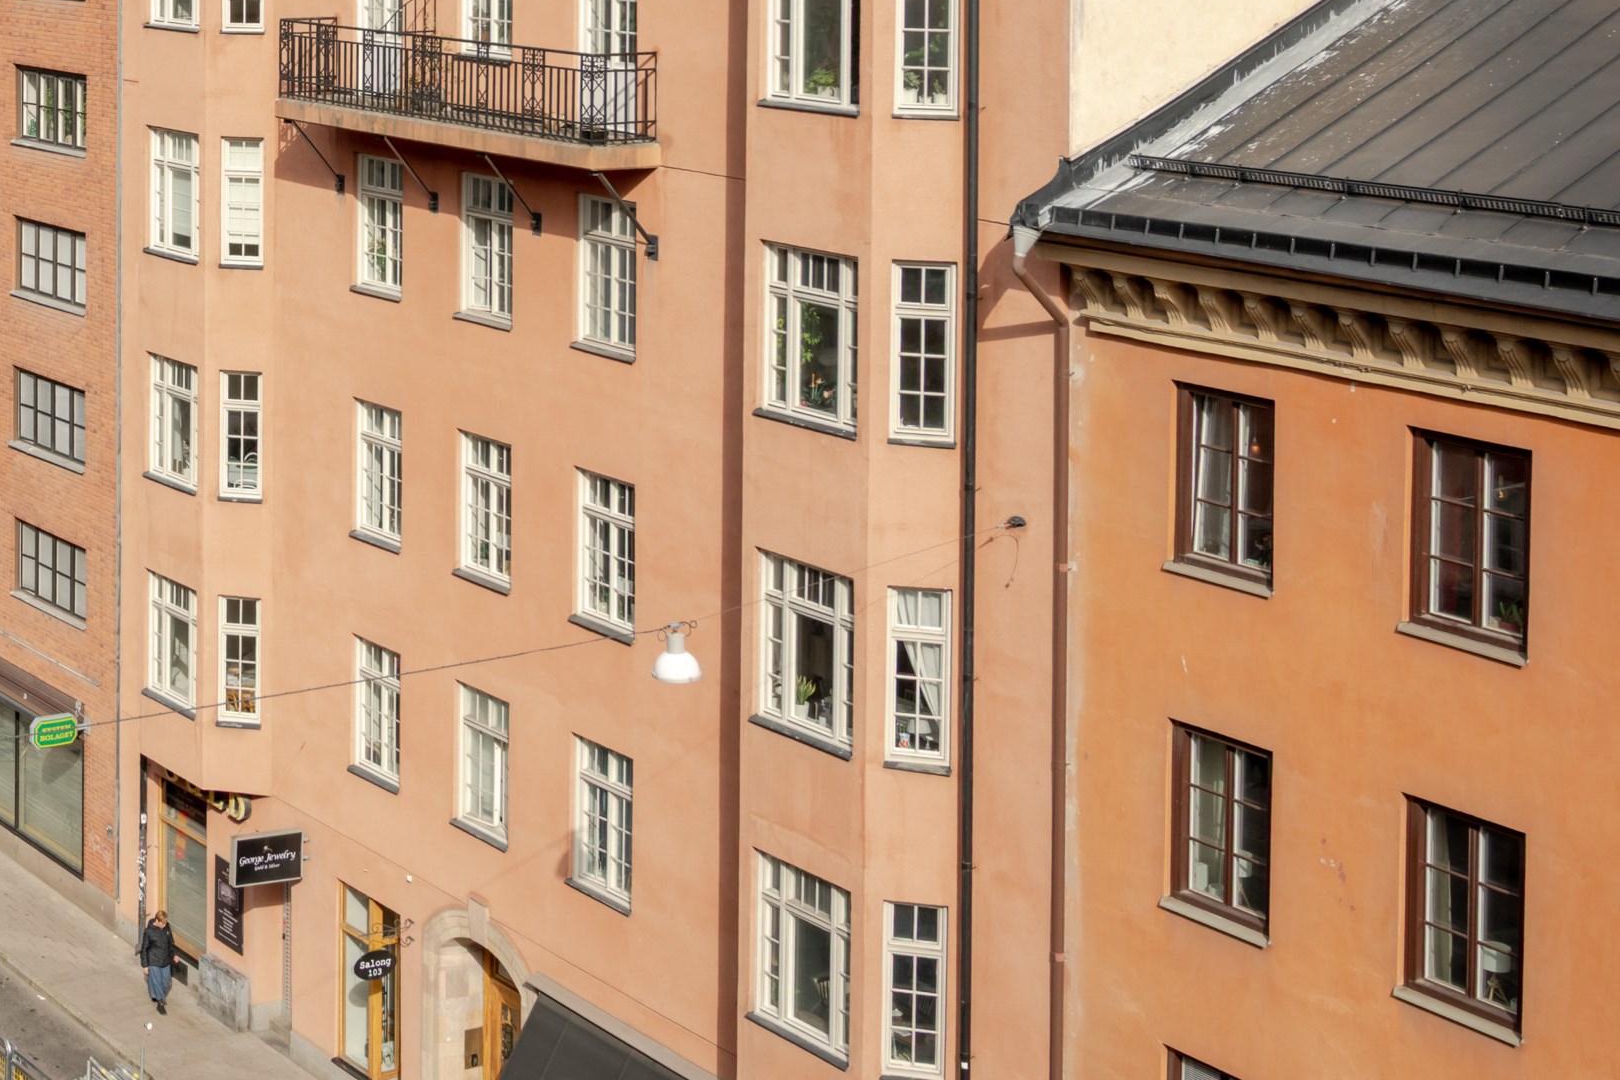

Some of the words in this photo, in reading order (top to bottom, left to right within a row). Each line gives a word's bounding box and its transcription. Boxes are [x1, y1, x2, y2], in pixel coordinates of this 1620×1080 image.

[40, 731, 73, 741] BOLAGET
[239, 855, 264, 866] George
[265, 849, 296, 863] Jewelry
[359, 958, 391, 970] Salong
[368, 967, 383, 977] 103
